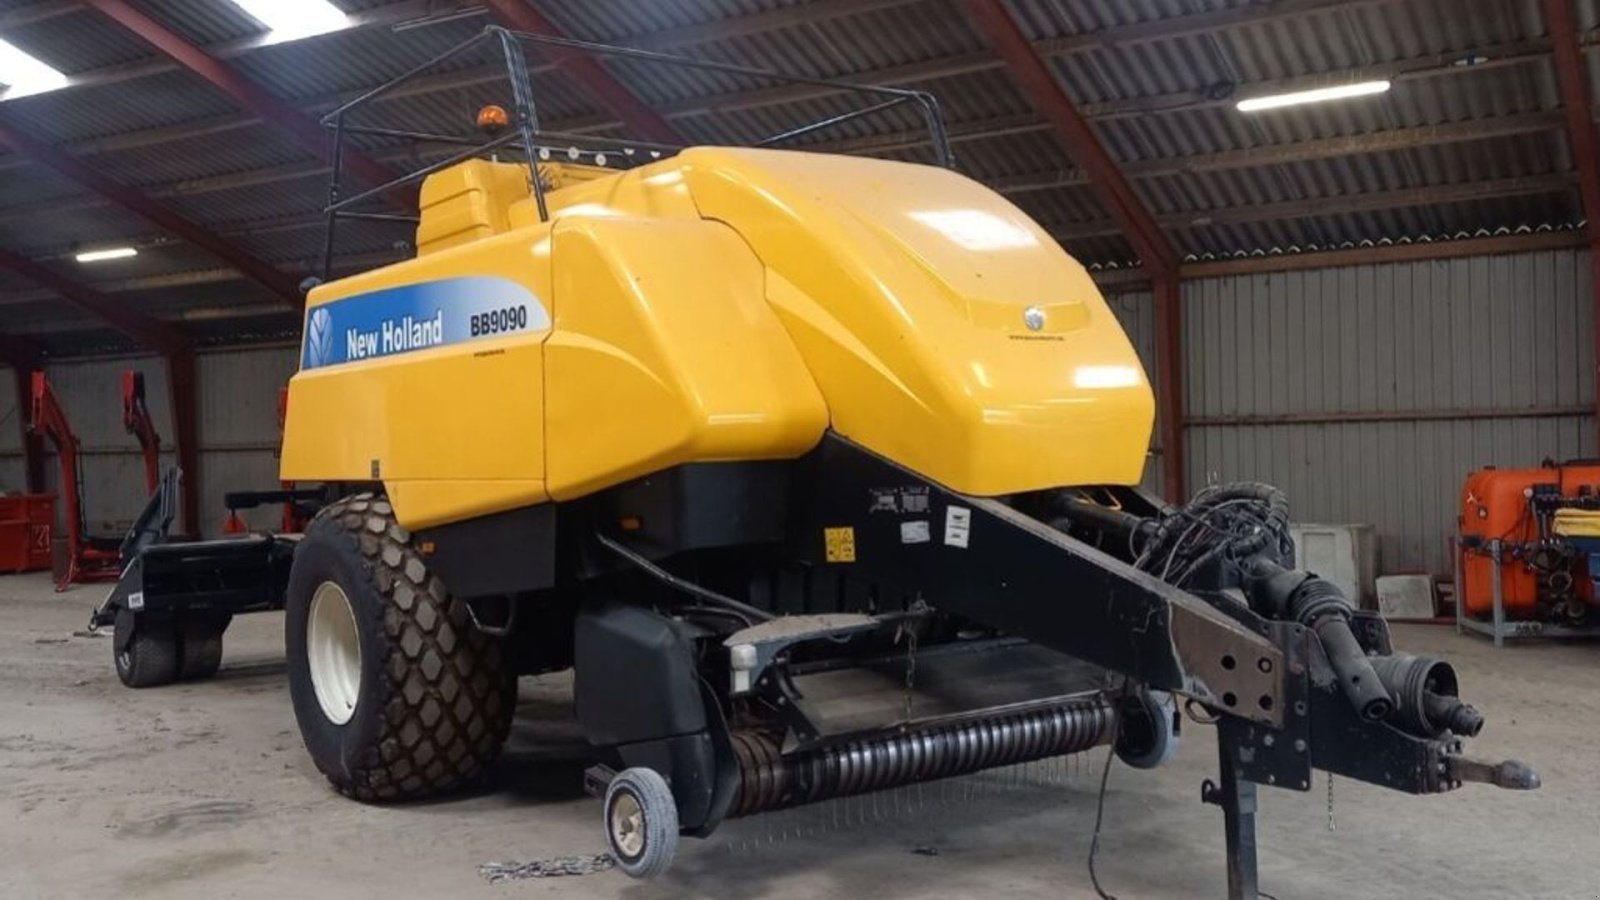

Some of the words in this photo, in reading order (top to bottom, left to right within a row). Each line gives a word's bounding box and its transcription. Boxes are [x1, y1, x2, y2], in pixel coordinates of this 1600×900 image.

[346, 328, 378, 360] New
[382, 310, 442, 353] Holland
[471, 305, 527, 337] BB9090
